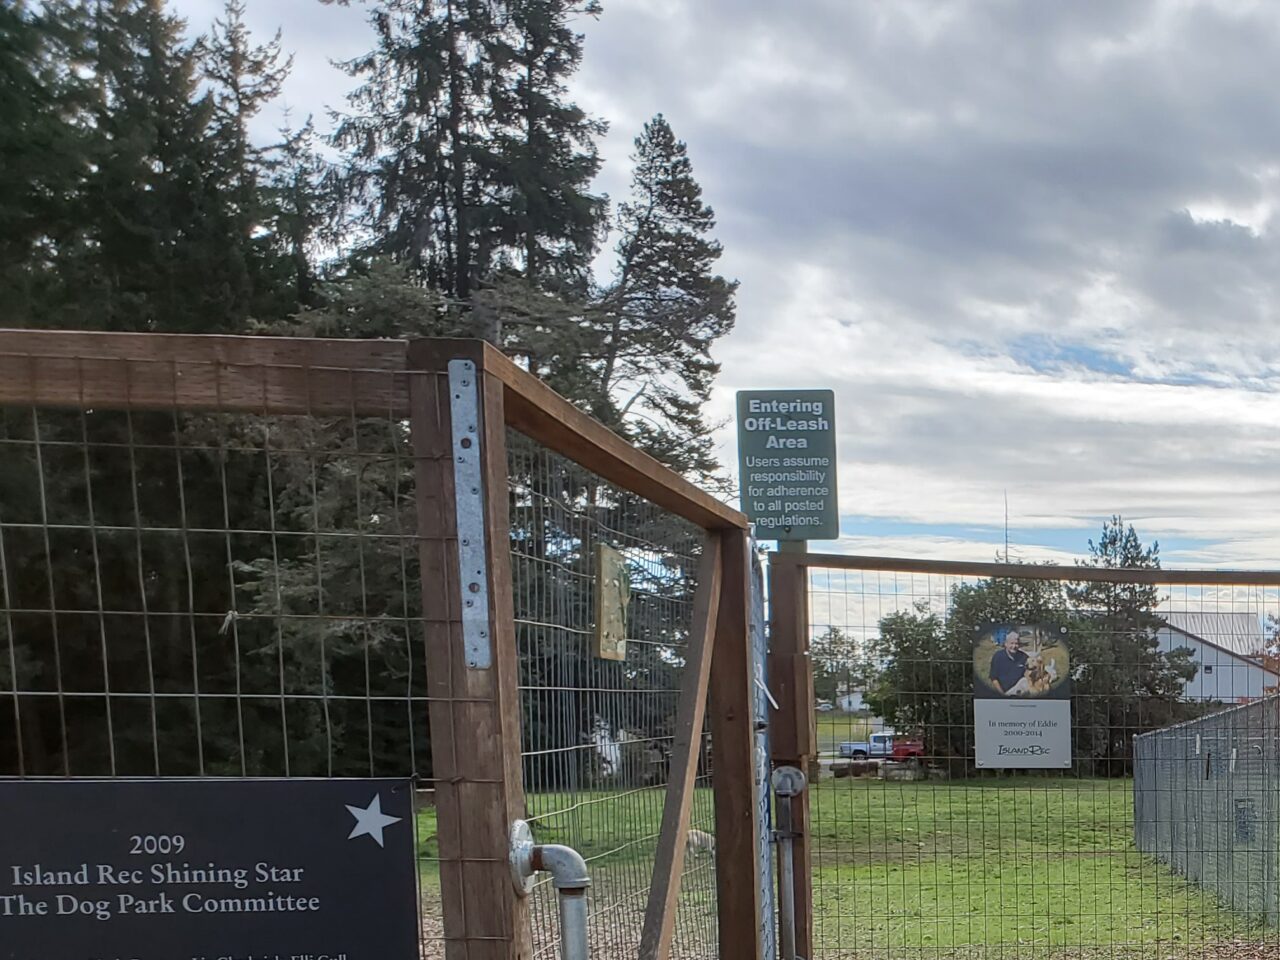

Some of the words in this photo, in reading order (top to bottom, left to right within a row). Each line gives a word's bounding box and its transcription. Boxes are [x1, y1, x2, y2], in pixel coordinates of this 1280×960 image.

[750, 400, 822, 415] Entering
[745, 418, 828, 430] Off-Leash
[766, 436, 807, 448] Area
[746, 456, 779, 467] Users
[783, 457, 829, 467] assume
[750, 470, 825, 483] responsibility
[748, 486, 763, 496] for
[767, 486, 829, 496] adherence
[754, 502, 764, 511] to
[768, 501, 782, 511] all
[785, 500, 824, 512] posted
[756, 516, 823, 528] regulations.
[129, 835, 184, 853] 2009
[11, 863, 89, 885] Island
[96, 864, 142, 884] Rec
[150, 862, 248, 887] Shining
[255, 862, 303, 882] Star
[0, 894, 47, 915] The
[55, 894, 110, 920] Dog
[116, 892, 175, 913] Park
[182, 892, 319, 912] Committee
